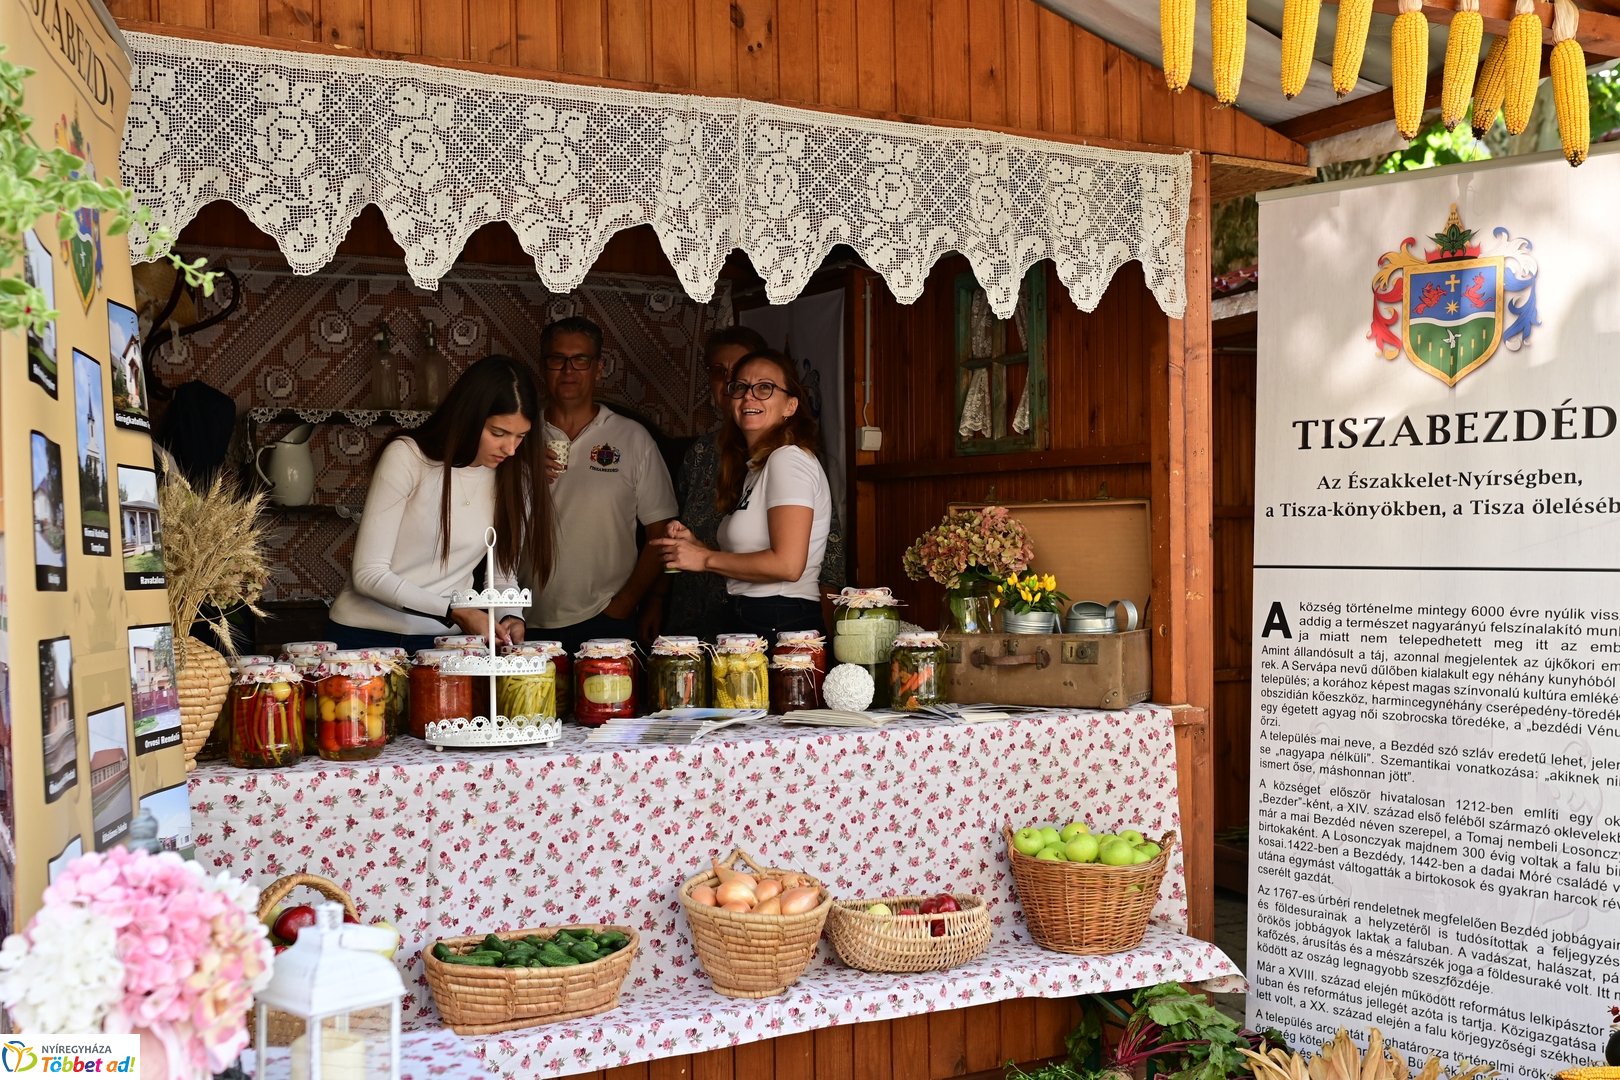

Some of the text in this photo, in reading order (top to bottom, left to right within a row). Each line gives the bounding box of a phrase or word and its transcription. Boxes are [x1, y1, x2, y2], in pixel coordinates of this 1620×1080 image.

[1292, 398, 1618, 450] TISZABEZDÉD
[1316, 468, 1583, 490] Az Északkelet-Nyírségben,
[1265, 506, 1274, 518] a
[1280, 501, 1446, 520] Tisza-könyökben,
[1453, 504, 1463, 516] a
[1470, 499, 1525, 516] Tisza
[1262, 602, 1292, 639] A
[1299, 601, 1585, 622] község történelme mintegy 6000 évre nyúlik
[1299, 616, 1582, 636] addig természet nagyarányú felszínalakító
[1261, 644, 1595, 672] Amint állandósult azonnal megjelentek újkőkori
[1320, 631, 1548, 652] miatt nem telepedhetett meg itt
[1261, 673, 1566, 702] település; korához képest magas színvonalú kultúra
[1292, 660, 1616, 689] Servápa nevű dűlőben kialakult néhány kunyhóból
[1260, 687, 1482, 714] obszidián kőeszköz, harmincegynéhány
[1281, 703, 1318, 716] égetett
[1322, 708, 1356, 721] agyag
[1382, 711, 1447, 725] szobrocska
[1452, 715, 1509, 731] töredéke,
[1260, 715, 1280, 727] őrzi.
[1269, 731, 1586, 769] település neve, Bezdéd szláv eredetű lehet,
[1380, 754, 1450, 771] Szemantikai
[1456, 764, 1538, 779] vonatkozása:
[1260, 758, 1290, 771] ismert
[1319, 764, 1385, 780] máshonnan
[1273, 780, 1558, 820] községet először hivatalosan 1212-ben említi
[1313, 813, 1558, 852] Bezdéd néven szerepel, Tomaj nembeli
[1373, 806, 1414, 820] század
[1417, 810, 1442, 823] első
[1444, 812, 1485, 828] feléből
[1488, 820, 1550, 836] származó
[1258, 820, 1600, 874] birtokaként. Losonczyak majdnem évig voltak falu
[1257, 866, 1334, 885] cserélt gazdát.
[1258, 850, 1598, 907] utána egymást váltogatták birtokosok gyakran harcok
[1353, 847, 1406, 866] Bezdédy,
[1410, 854, 1464, 872] 1442-ben
[1480, 864, 1515, 879] dadai
[1519, 869, 1552, 884] Móré
[1556, 876, 1608, 892] családé
[1274, 887, 1548, 939] 1767-es úrbéri rendeletnek megfelelően Bezdéd
[1275, 901, 1528, 952] földesurainak helyzetéről tudósítottak
[1257, 913, 1596, 982] örökös jobbágyok laktak faluban. vadászat, halászat,
[1257, 926, 1592, 996] kafőzés, árusítás mészárszék joga földesuraké volt.
[1257, 941, 1493, 995] ködött oszág legnagyobb szeszfőzdéje.
[1256, 974, 1596, 1052] luban református jellegét azóta tartja. Közigazgatása
[1288, 966, 1605, 1036] XVIII. század elején működött református lelkipásztor
[1256, 988, 1536, 1058] lett volt, század elején falu körjegyzőségi
